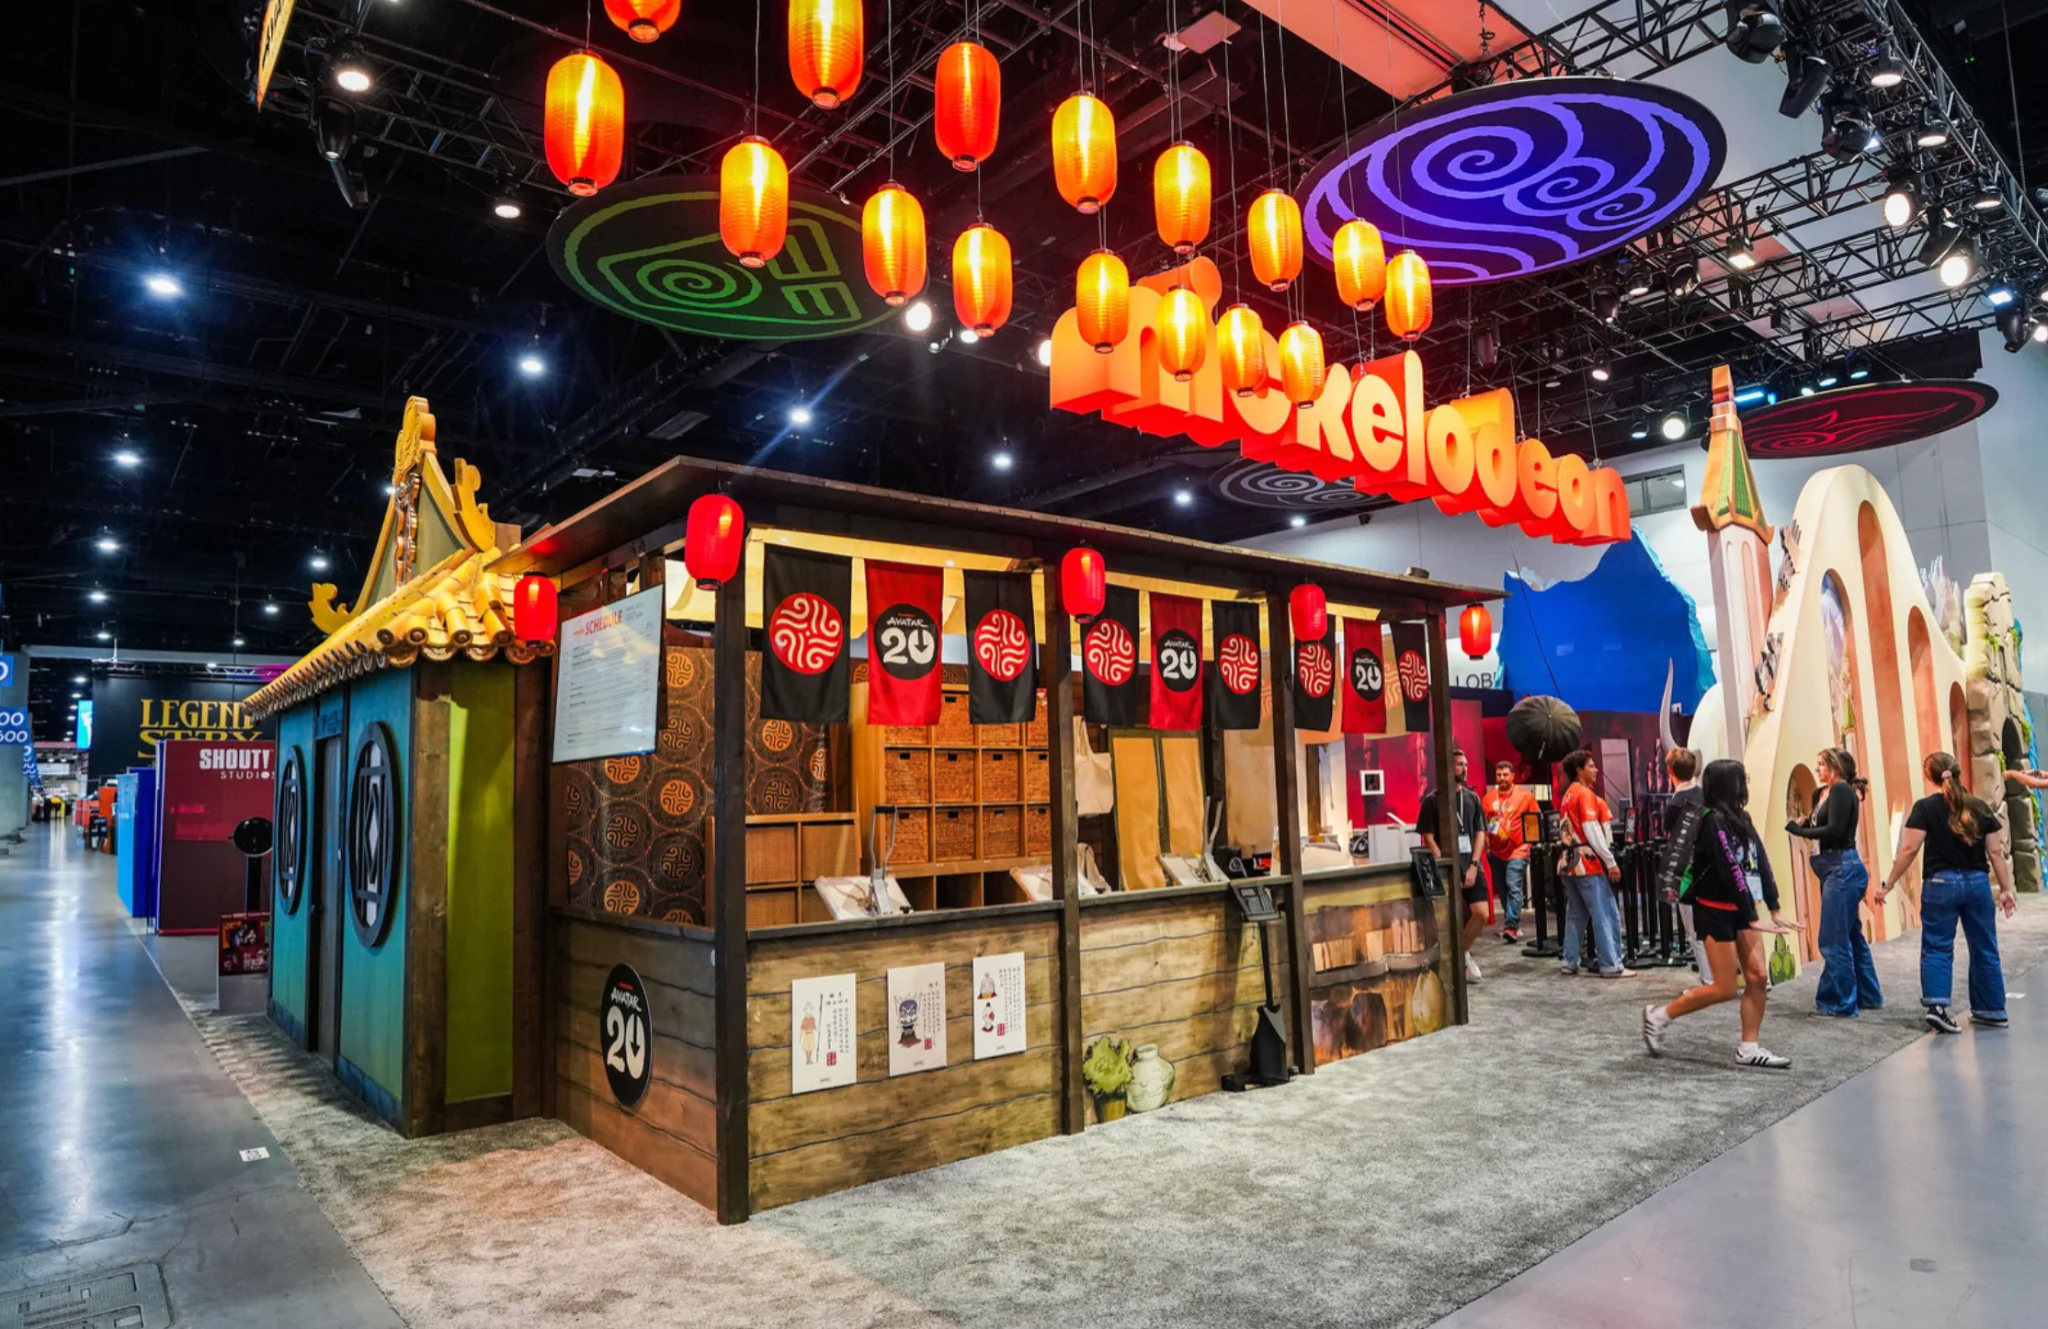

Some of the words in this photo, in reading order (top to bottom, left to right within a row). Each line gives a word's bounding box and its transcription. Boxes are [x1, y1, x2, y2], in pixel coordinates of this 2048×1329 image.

[886, 616, 929, 628] AVATAR
[881, 627, 936, 665] 20
[1164, 639, 1194, 649] AVATAR
[1161, 648, 1197, 680] 20
[1356, 664, 1382, 690] 20
[199, 748, 270, 770] SHOUT!
[610, 986, 642, 1013] AVATAR
[606, 1005, 646, 1080] 20
